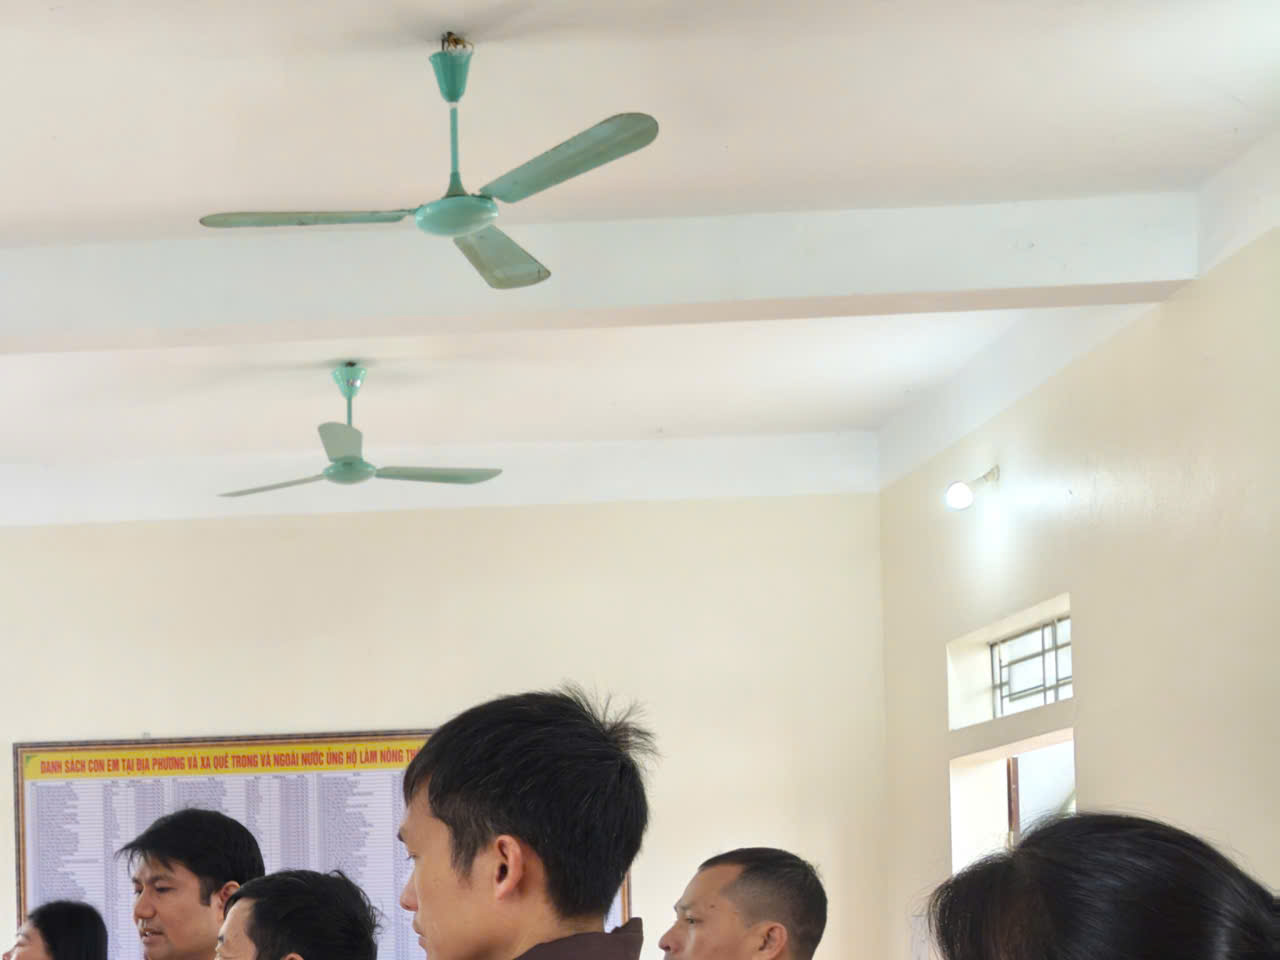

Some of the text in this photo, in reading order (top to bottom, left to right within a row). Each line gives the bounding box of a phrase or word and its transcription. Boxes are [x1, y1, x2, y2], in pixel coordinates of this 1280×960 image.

[40, 760, 62, 775] DANH
[88, 759, 105, 773] CON
[107, 758, 120, 773] EM
[231, 754, 258, 769] TRONG
